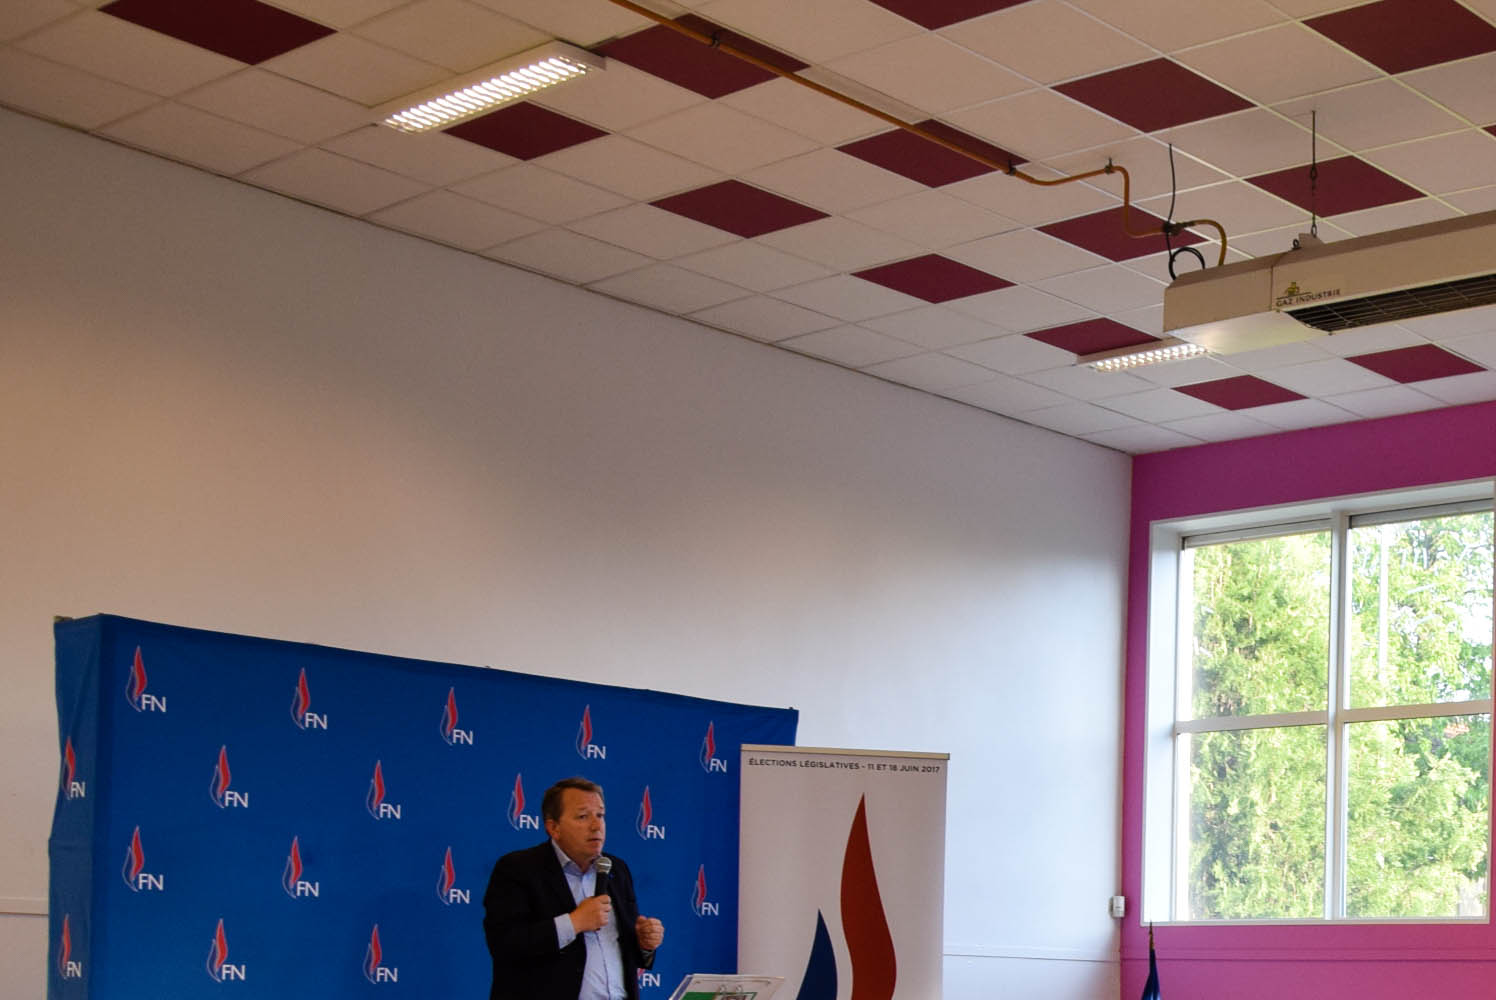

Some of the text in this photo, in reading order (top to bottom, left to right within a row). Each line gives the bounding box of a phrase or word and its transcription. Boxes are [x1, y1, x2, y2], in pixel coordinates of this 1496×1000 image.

[141, 694, 167, 713] FN
[304, 712, 328, 730] FN
[452, 729, 474, 746] FN
[586, 744, 607, 760] FN
[708, 758, 728, 773] FN
[749, 758, 797, 768] ÉLECTIONS
[799, 760, 860, 770] LÉGISLATIVES
[868, 763, 875, 771] 11
[900, 765, 920, 773] JUIN
[921, 766, 940, 774] 2017
[70, 781, 86, 799] FN
[224, 791, 249, 808] FN
[378, 804, 402, 820] FN
[519, 814, 540, 830] FN
[646, 825, 666, 840] FN
[138, 874, 164, 891] FN
[296, 882, 320, 898] FN
[449, 889, 471, 904] FN
[701, 902, 719, 917] FN
[66, 961, 82, 978] FN
[221, 965, 246, 981] FN
[375, 967, 399, 983] FN
[642, 973, 661, 987] FN
